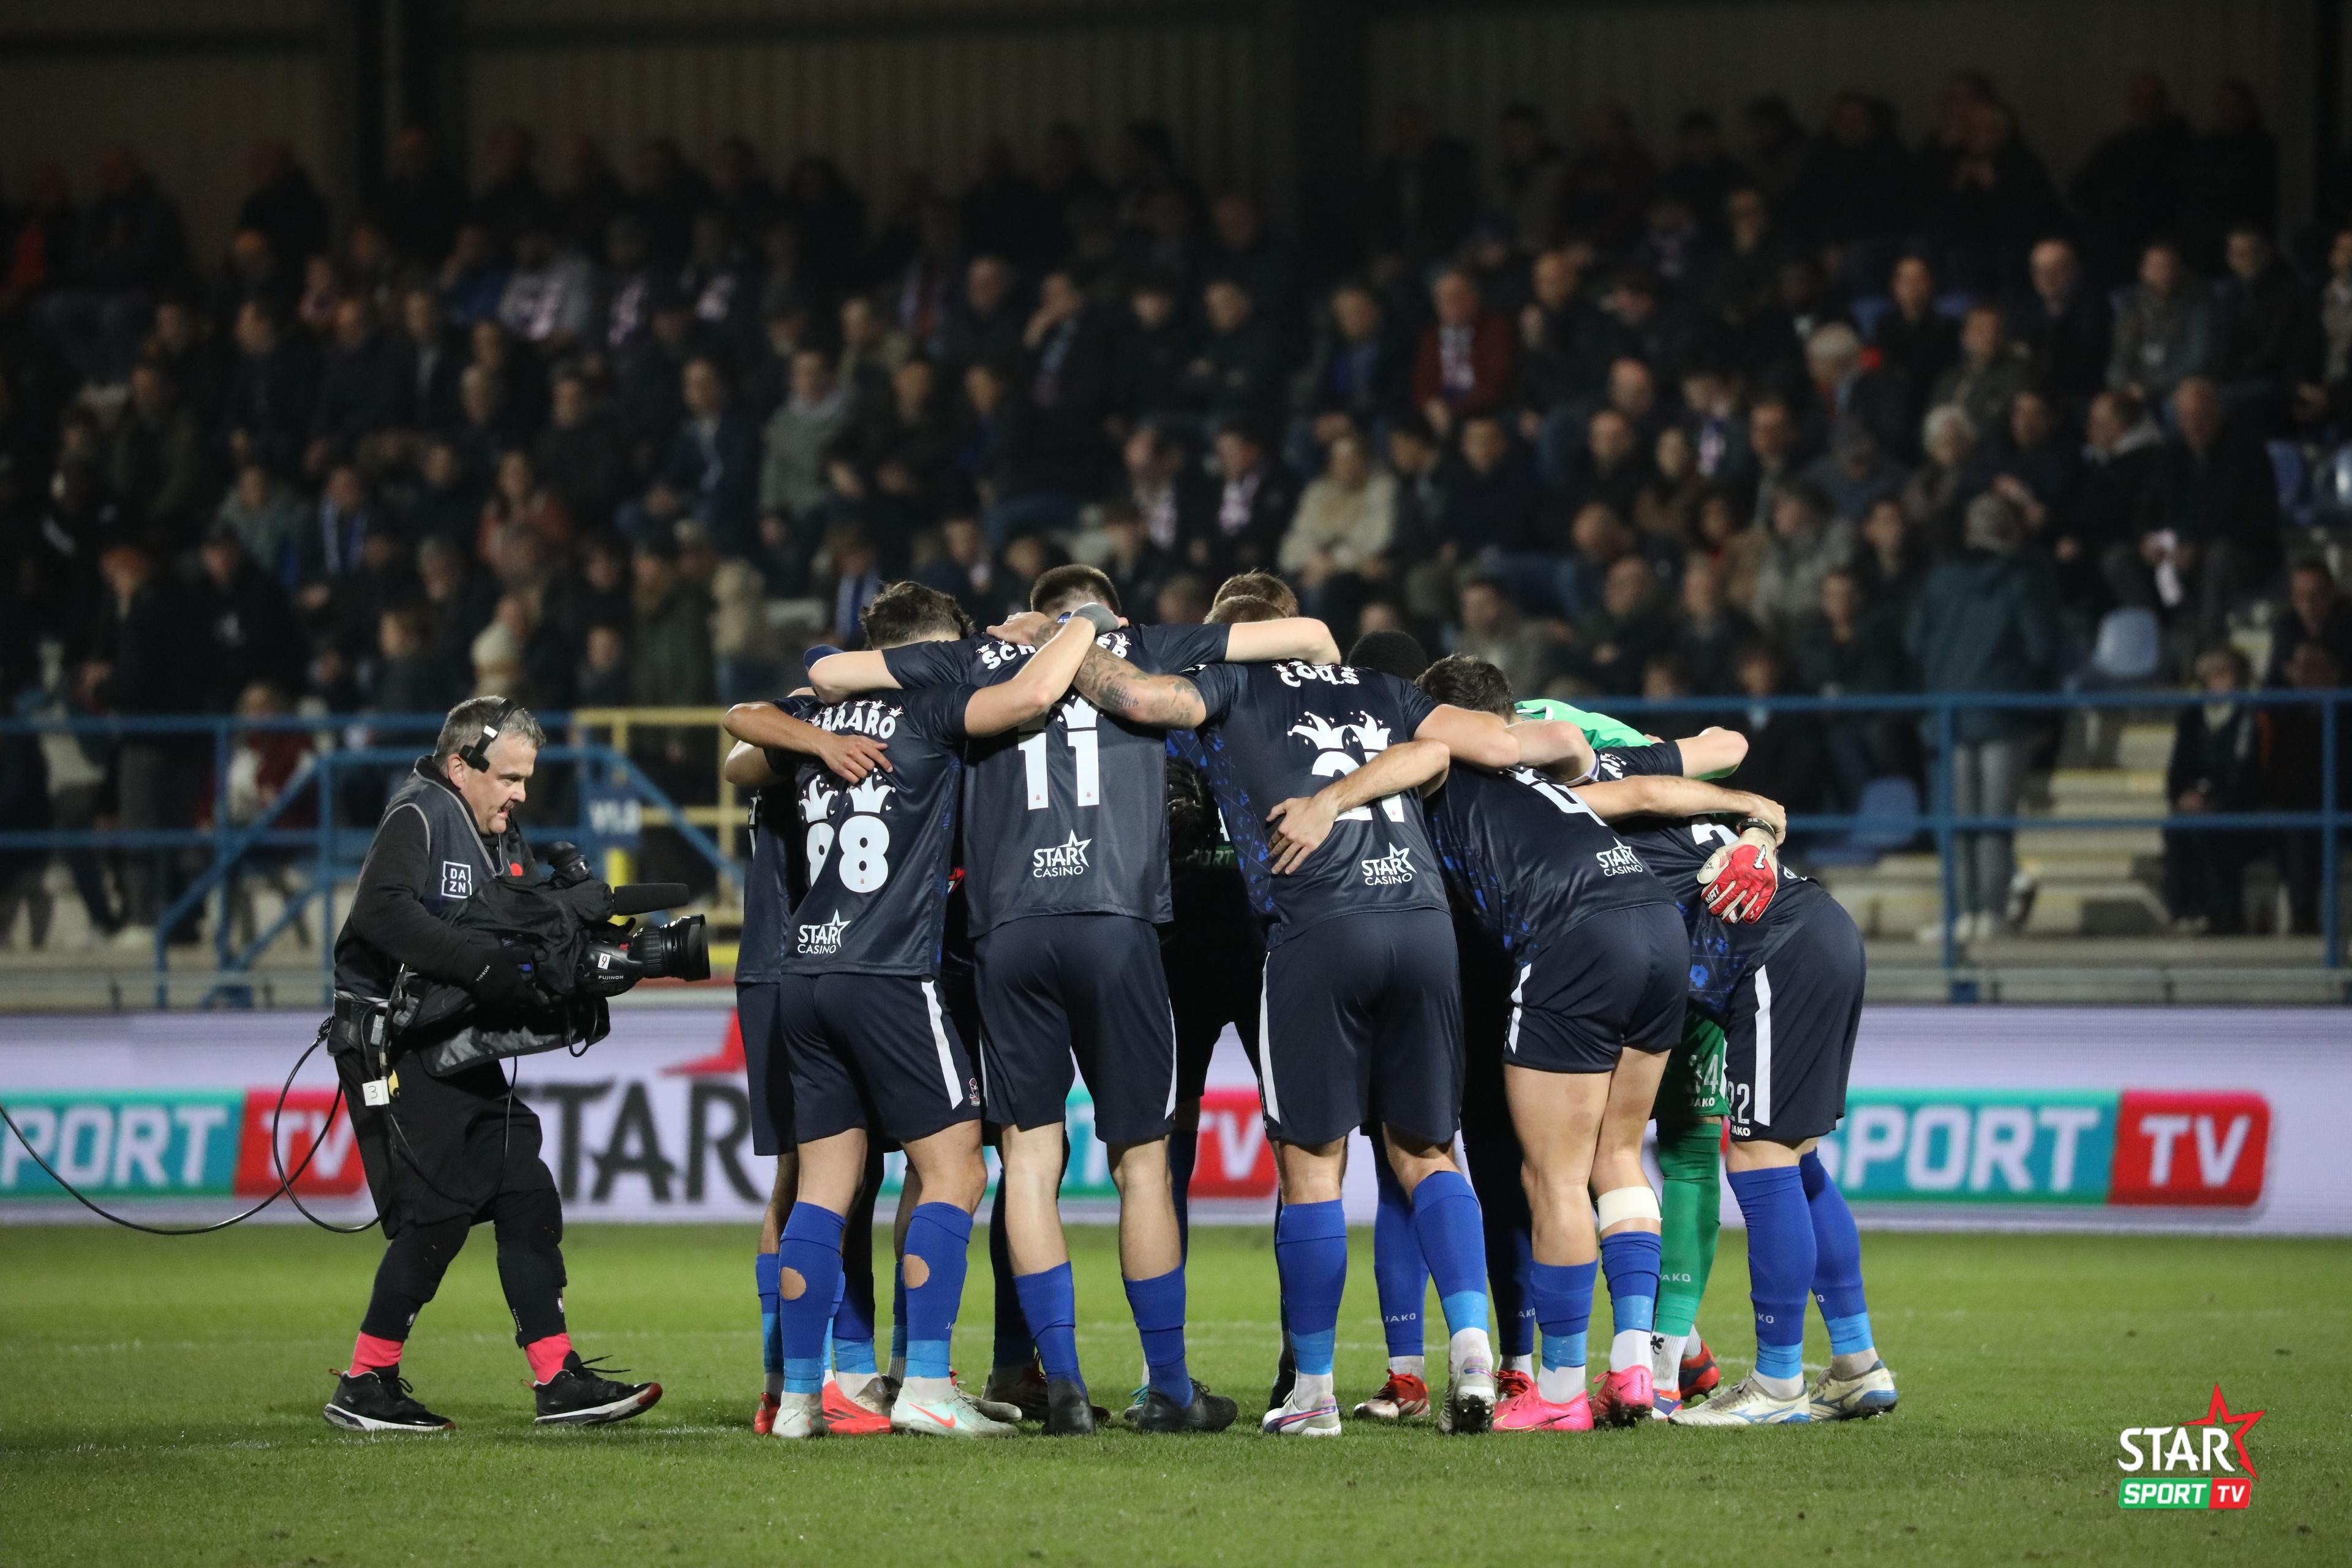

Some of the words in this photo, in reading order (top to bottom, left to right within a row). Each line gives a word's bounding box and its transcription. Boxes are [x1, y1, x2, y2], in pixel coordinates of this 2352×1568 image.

[1018, 729, 1100, 810] 11
[1033, 847, 1081, 868] STAR
[1596, 848, 1637, 869] STAR
[1033, 865, 1084, 878] CASINO
[1361, 858, 1408, 876] STAR
[1604, 864, 1643, 877] CASINO
[450, 868, 466, 881] DA
[1365, 872, 1412, 886] CASINO
[449, 881, 466, 893] ZN
[797, 924, 839, 944] STAR
[797, 944, 837, 954] CASINO
[601, 956, 608, 967] 9
[368, 1085, 378, 1099] 3
[516, 1076, 766, 1205] TAR
[2139, 1114, 2252, 1187] TV
[1659, 1273, 1691, 1282] AKO
[1384, 1313, 1416, 1323] JAKO
[1517, 1307, 1536, 1318] AKO
